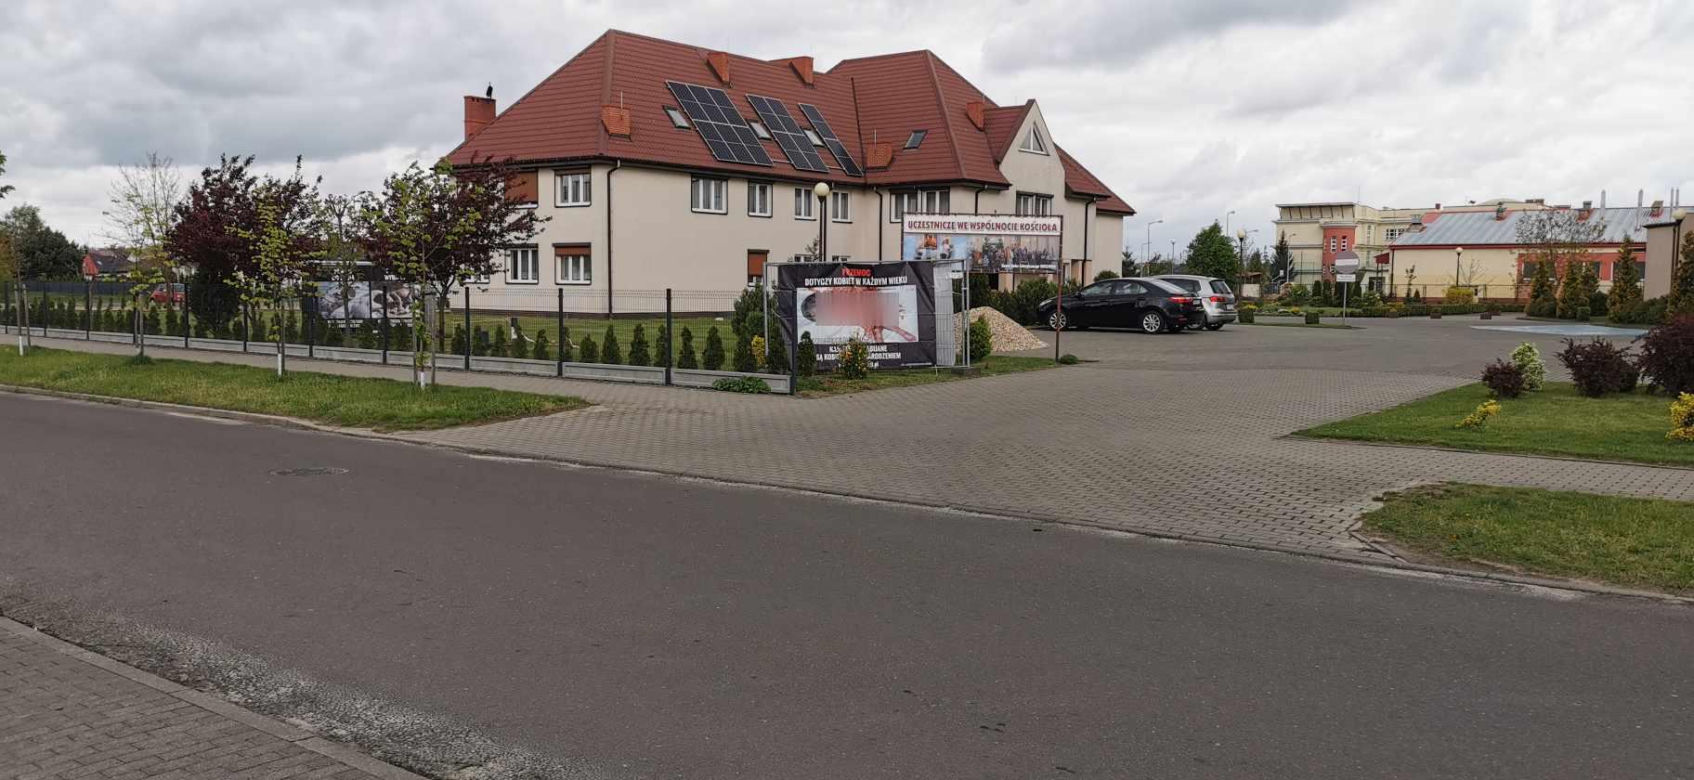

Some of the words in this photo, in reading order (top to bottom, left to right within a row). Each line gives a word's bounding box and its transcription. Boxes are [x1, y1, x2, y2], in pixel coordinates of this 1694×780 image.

[957, 221, 968, 230] WE
[970, 219, 1017, 231] WSPÓLNOCIE
[804, 278, 832, 286] DOTYCZY
[834, 277, 855, 285] KOBIET
[862, 277, 888, 286] KAŻDYM
[888, 276, 908, 284] WIEKU
